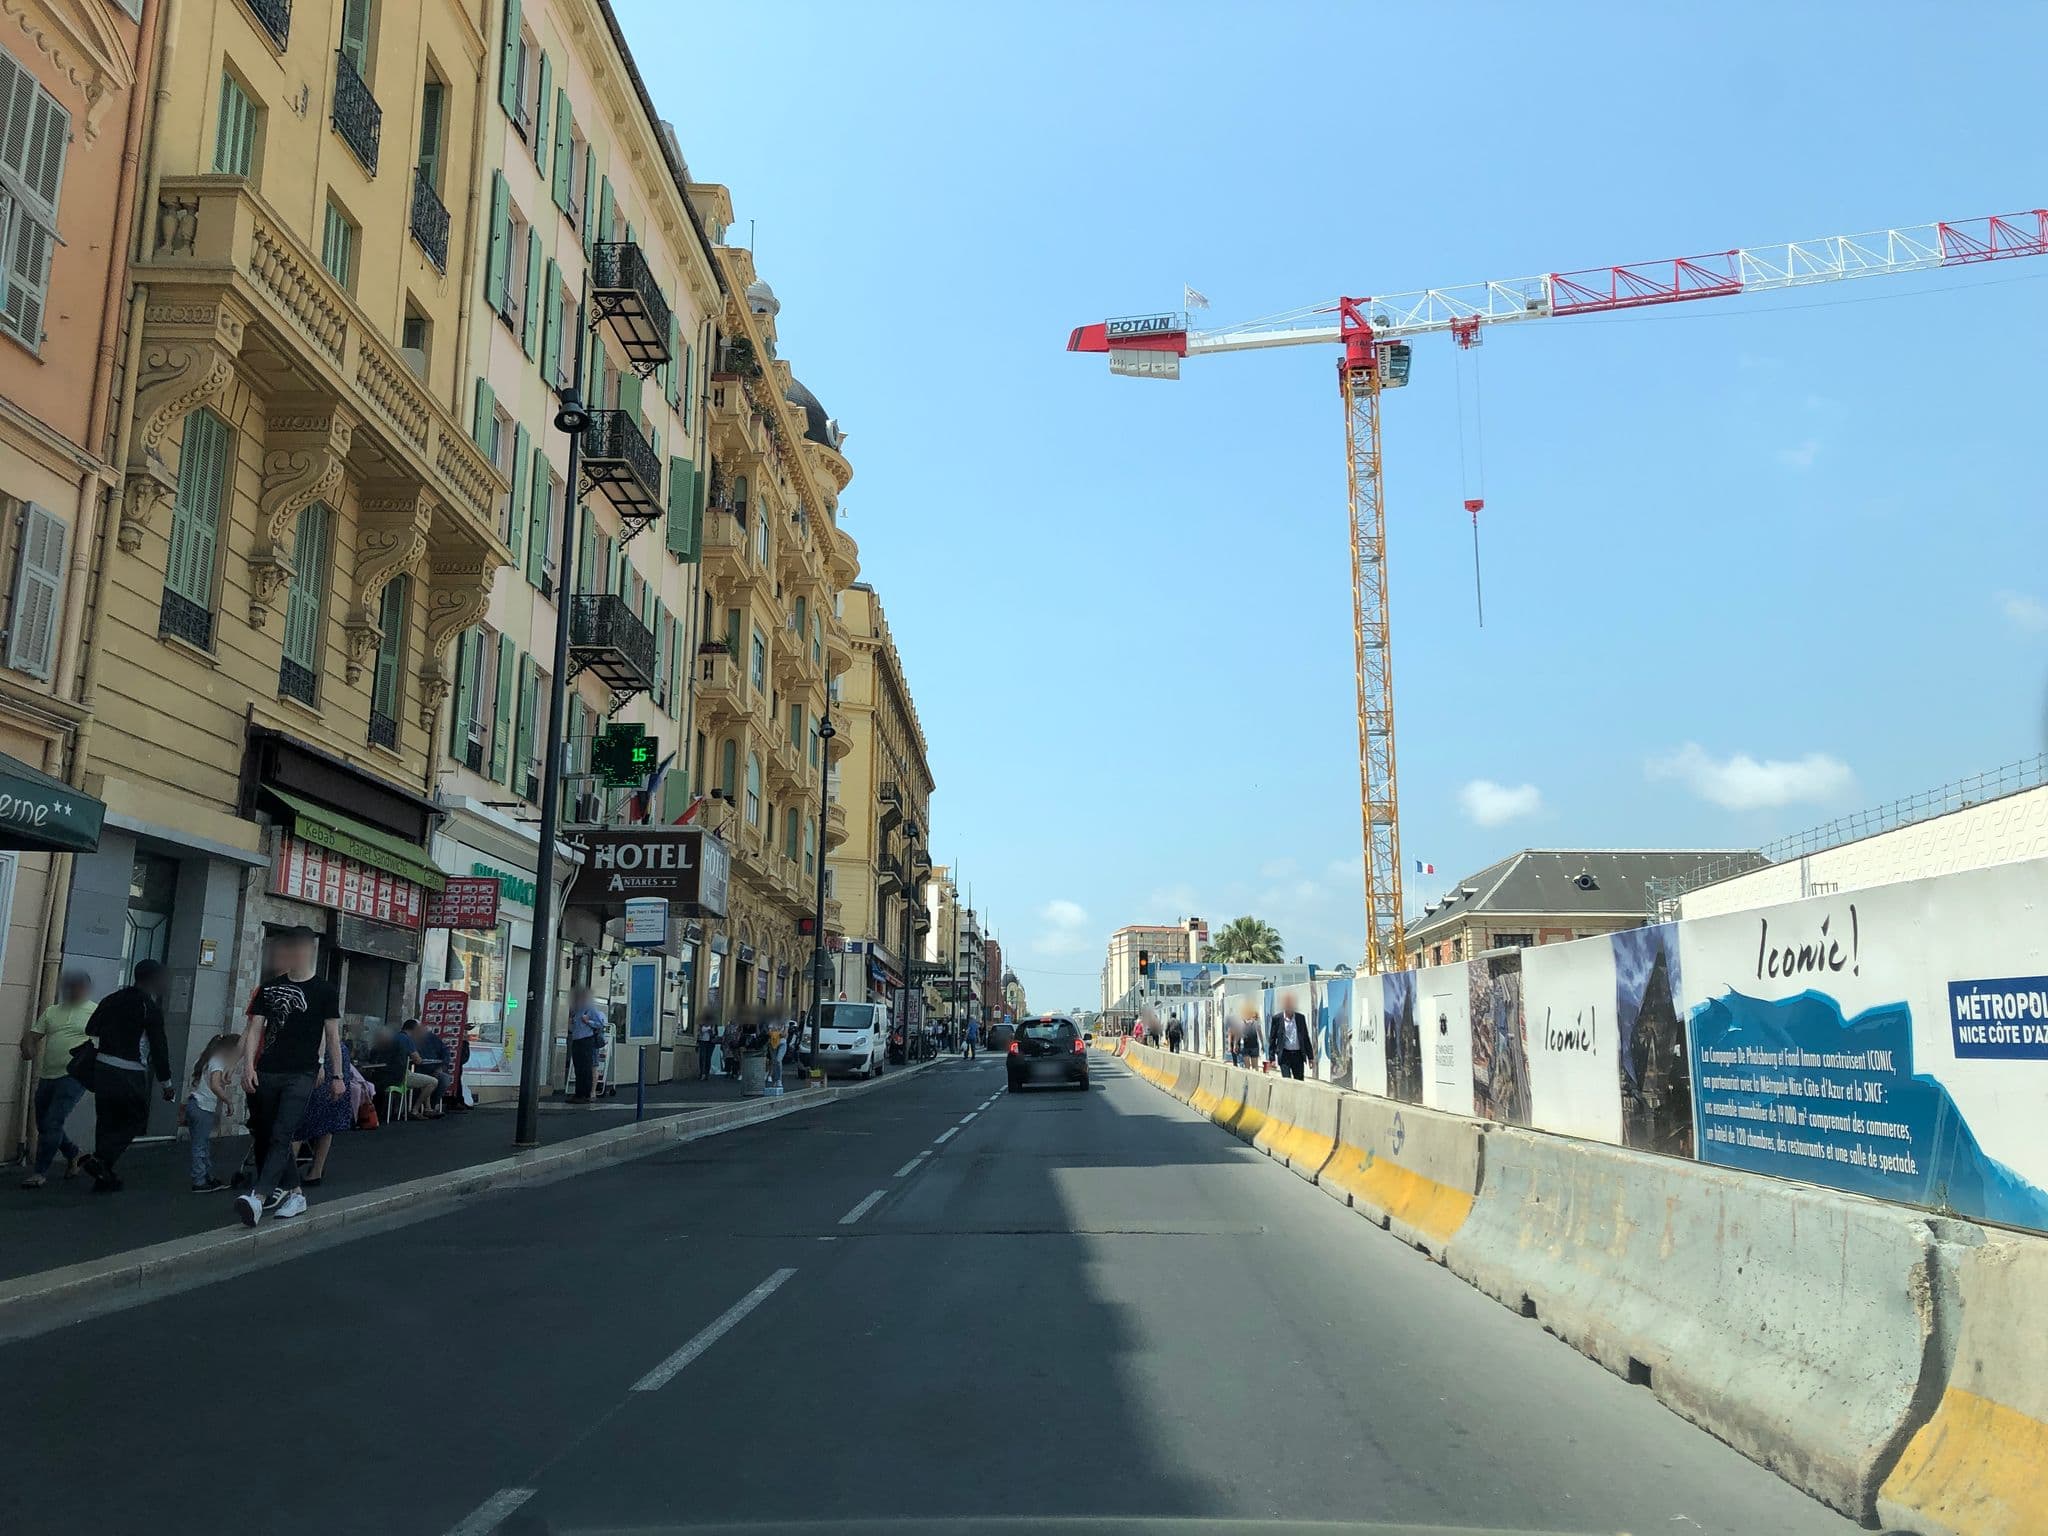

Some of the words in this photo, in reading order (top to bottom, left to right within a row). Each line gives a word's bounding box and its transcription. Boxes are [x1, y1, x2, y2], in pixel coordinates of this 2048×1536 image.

[1109, 318, 1170, 334] POTAIN
[1379, 347, 1387, 376] POTAIN
[632, 748, 647, 762] 15
[0, 794, 48, 826] erne
[305, 821, 336, 846] Kebab
[594, 843, 693, 869] HOTEL
[703, 842, 729, 883] HOTEL
[1757, 904, 1859, 980] Iconic!
[1545, 1005, 1597, 1057] Iconic!
[1959, 1025, 1987, 1044] NICE
[1988, 1020, 2021, 1044] CÔTE
[1701, 1046, 1709, 1063] La
[1822, 1050, 1866, 1070] construisent
[1867, 1050, 1897, 1076] ICONIC,
[1804, 1077, 1820, 1098] Côte
[1821, 1077, 1844, 1100] d'Azur
[1846, 1084, 1854, 1101] et
[1855, 1079, 1863, 1102] la
[1768, 1103, 1777, 1122] de
[1809, 1113, 1851, 1134] comprenant
[1852, 1111, 1865, 1134] des
[1866, 1119, 1913, 1145] commerces,
[1776, 1132, 1787, 1153] des
[1788, 1138, 1825, 1159] restaurants
[1826, 1143, 1834, 1161] et
[1834, 1148, 1848, 1163] une
[1849, 1143, 1867, 1166] salle
[1868, 1145, 1878, 1169] de
[1879, 1150, 1919, 1176] spectacle.
